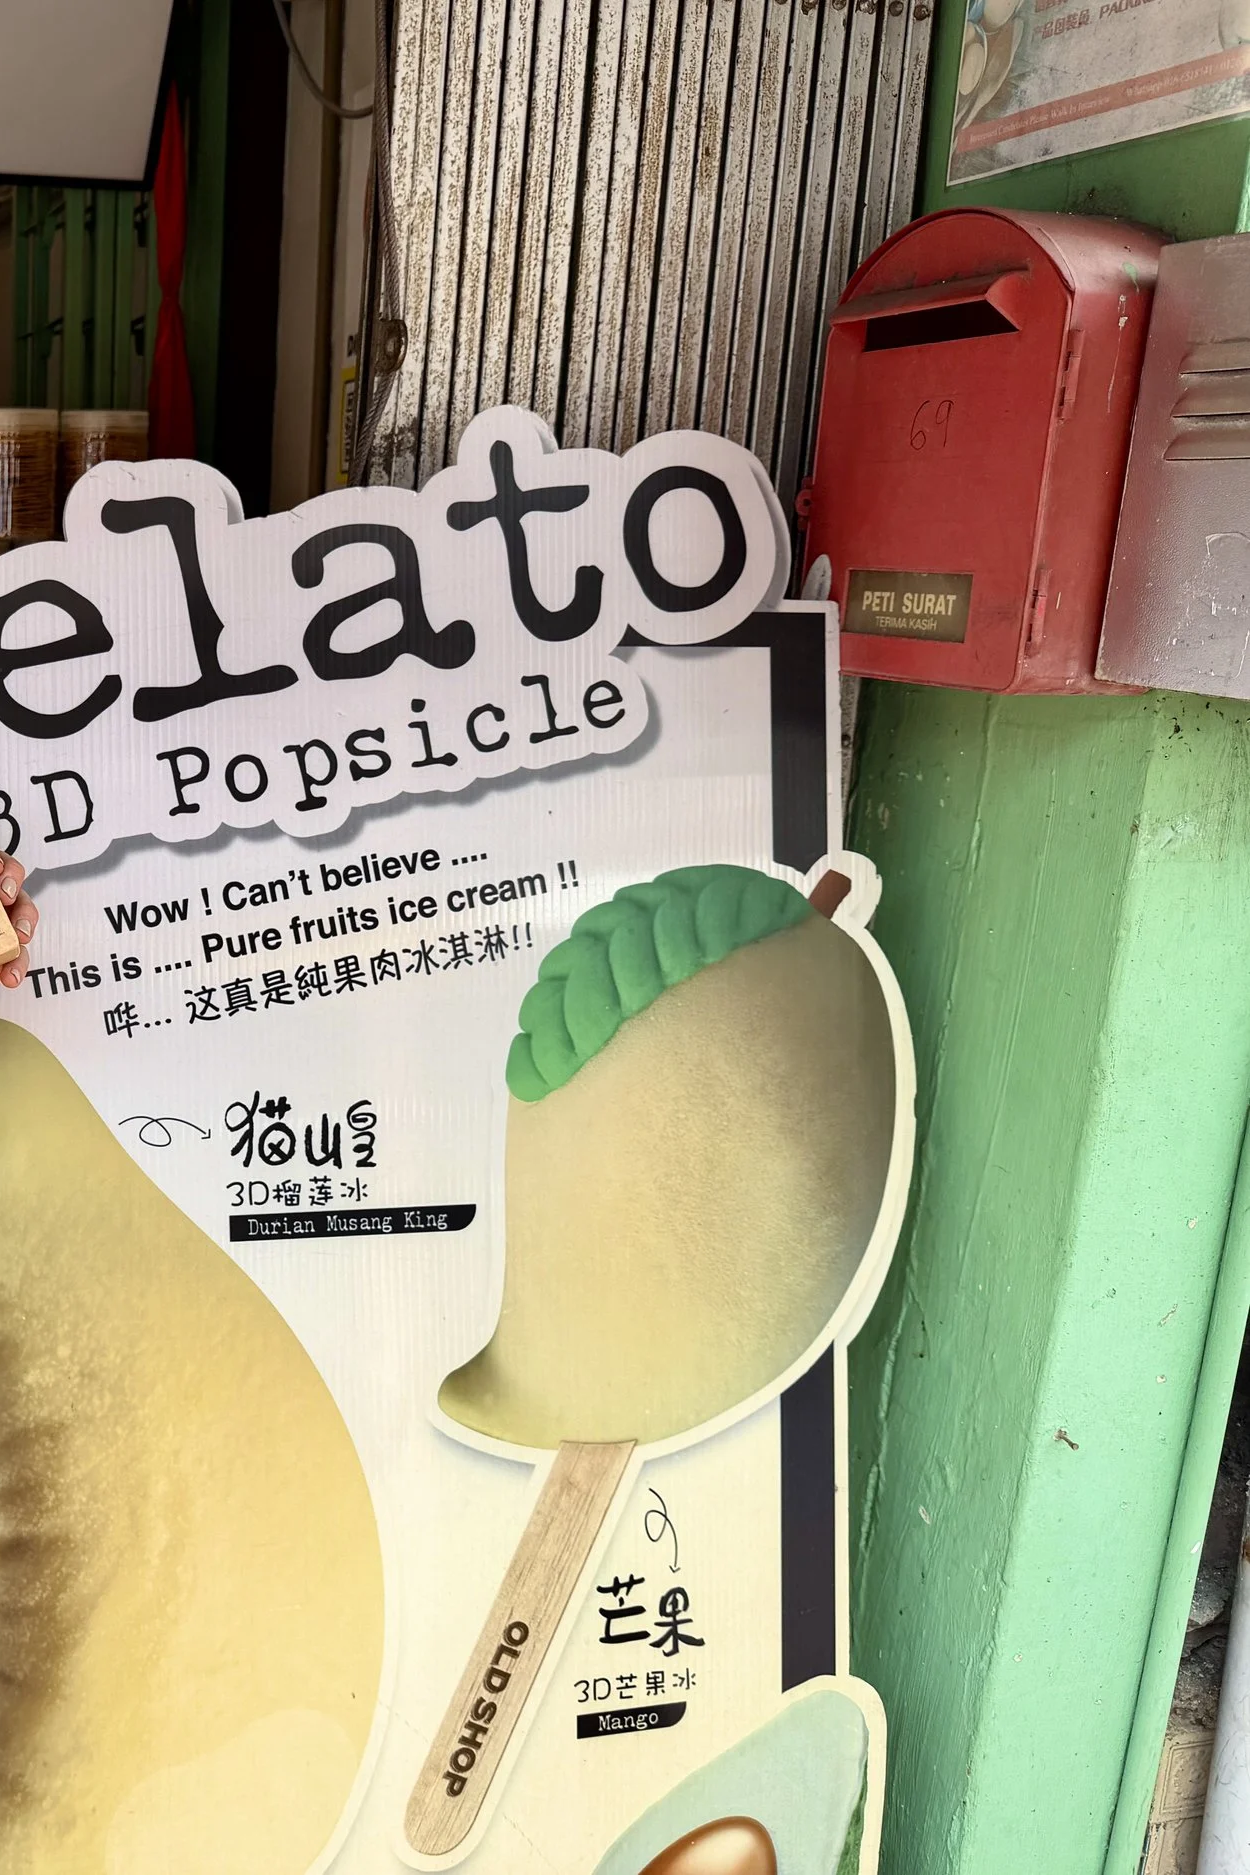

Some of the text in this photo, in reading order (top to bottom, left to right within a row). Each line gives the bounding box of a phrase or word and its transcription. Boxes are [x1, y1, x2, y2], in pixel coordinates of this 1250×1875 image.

[910, 400, 954, 450] 69
[862, 590, 957, 616] PETI SURAT
[875, 616, 938, 631] TERIMA KASIH
[156, 673, 626, 816] Popsicle
[105, 898, 189, 934] Wow
[222, 866, 313, 912] Can’t
[321, 845, 441, 892] believe
[26, 959, 102, 998] This
[112, 951, 142, 983] is
[201, 927, 282, 964] Pure
[289, 904, 379, 945] fruits
[390, 891, 439, 923] ice
[446, 873, 547, 913] cream
[247, 1210, 448, 1237] Durian Musang King
[596, 1574, 706, 1657] 芒果
[442, 1620, 530, 1798] OLD SHOP
[573, 1668, 697, 1703] 3D芒果冰
[598, 1710, 659, 1732] Mango
